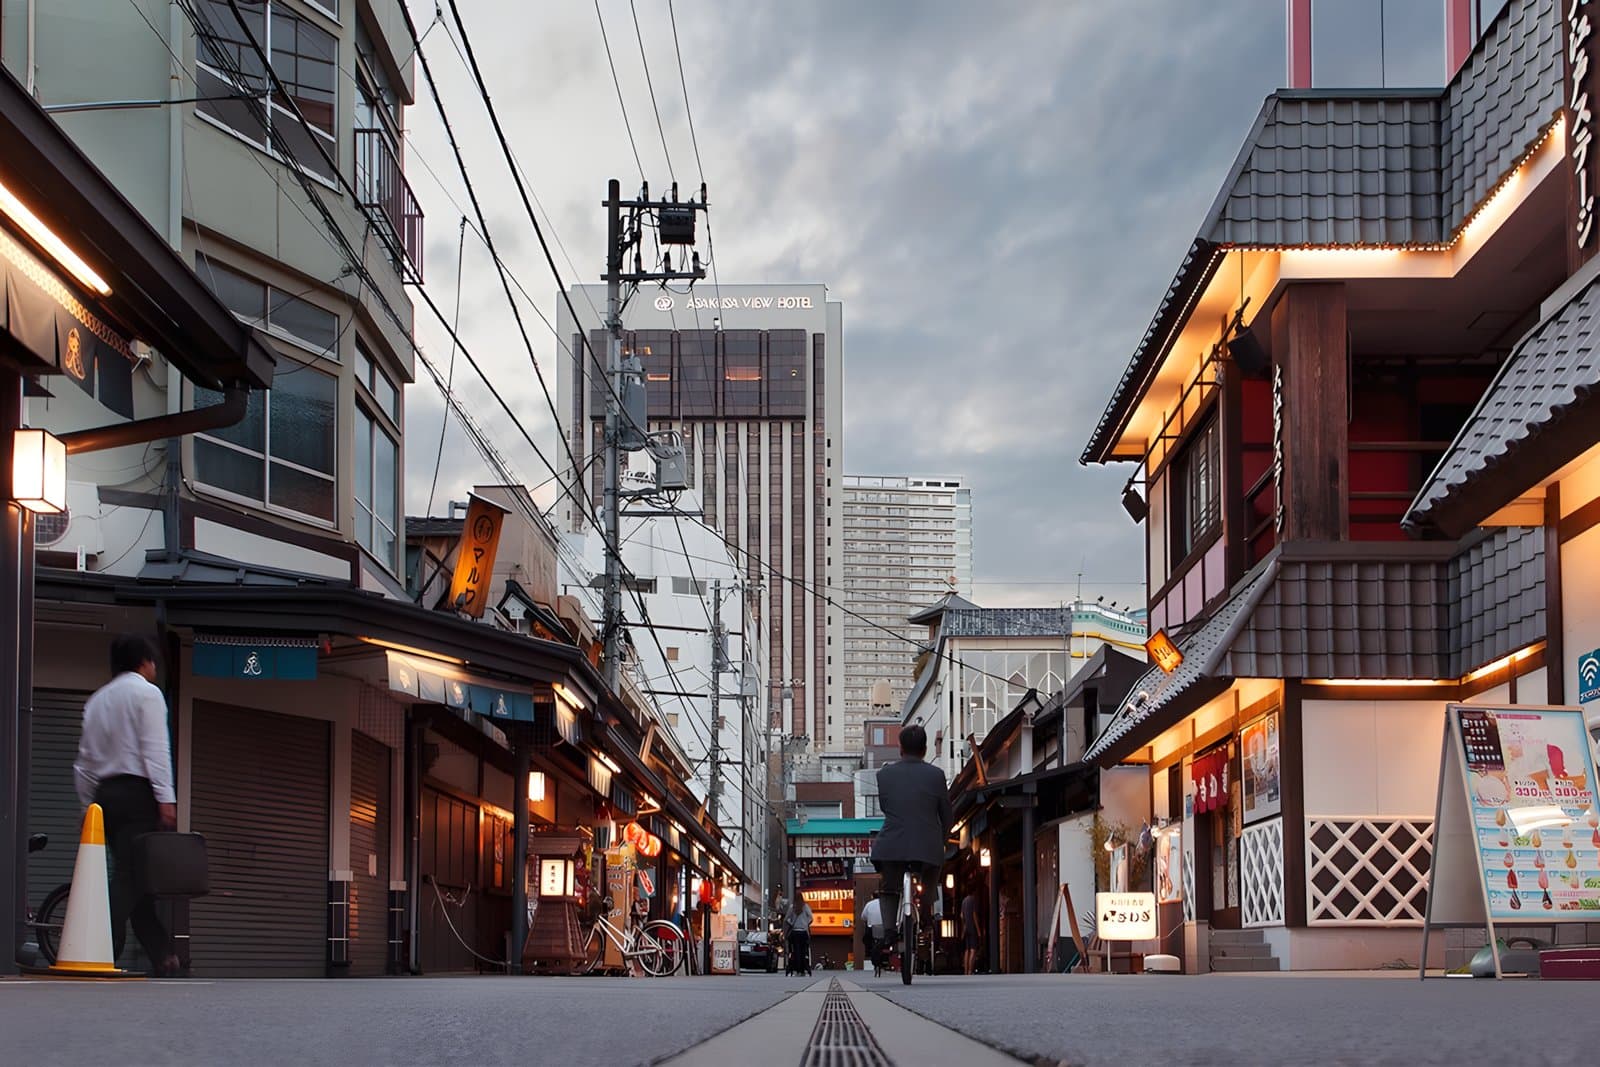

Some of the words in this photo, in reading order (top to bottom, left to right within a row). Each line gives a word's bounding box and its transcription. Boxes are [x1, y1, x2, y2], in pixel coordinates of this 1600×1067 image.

[686, 297, 739, 309] ASAKUSA
[742, 297, 774, 309] VIEW
[777, 297, 813, 310] HOTEL
